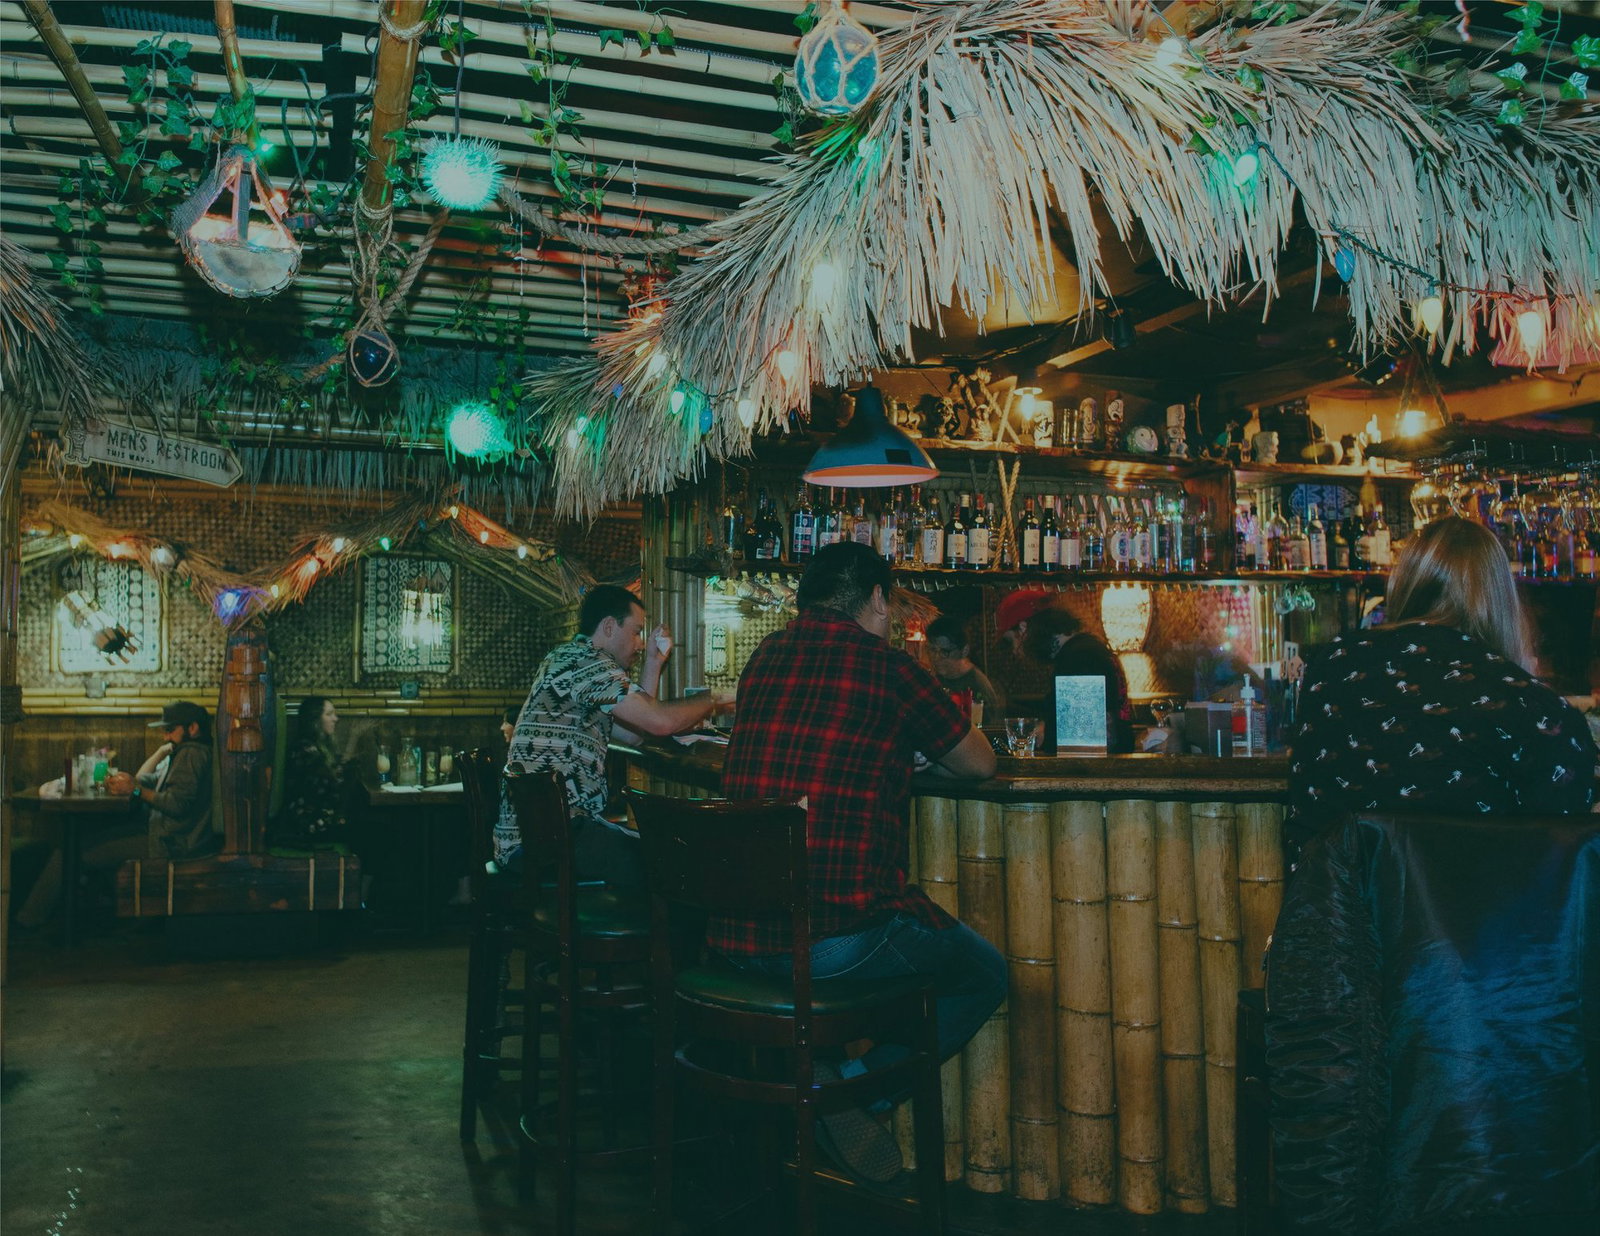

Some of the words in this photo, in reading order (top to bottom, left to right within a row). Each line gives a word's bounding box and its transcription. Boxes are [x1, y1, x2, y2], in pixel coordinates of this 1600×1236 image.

[106, 448, 125, 459] THIS
[129, 454, 145, 464] WAY
[107, 429, 147, 452] MEN'S
[156, 439, 229, 471] RESTROOM
